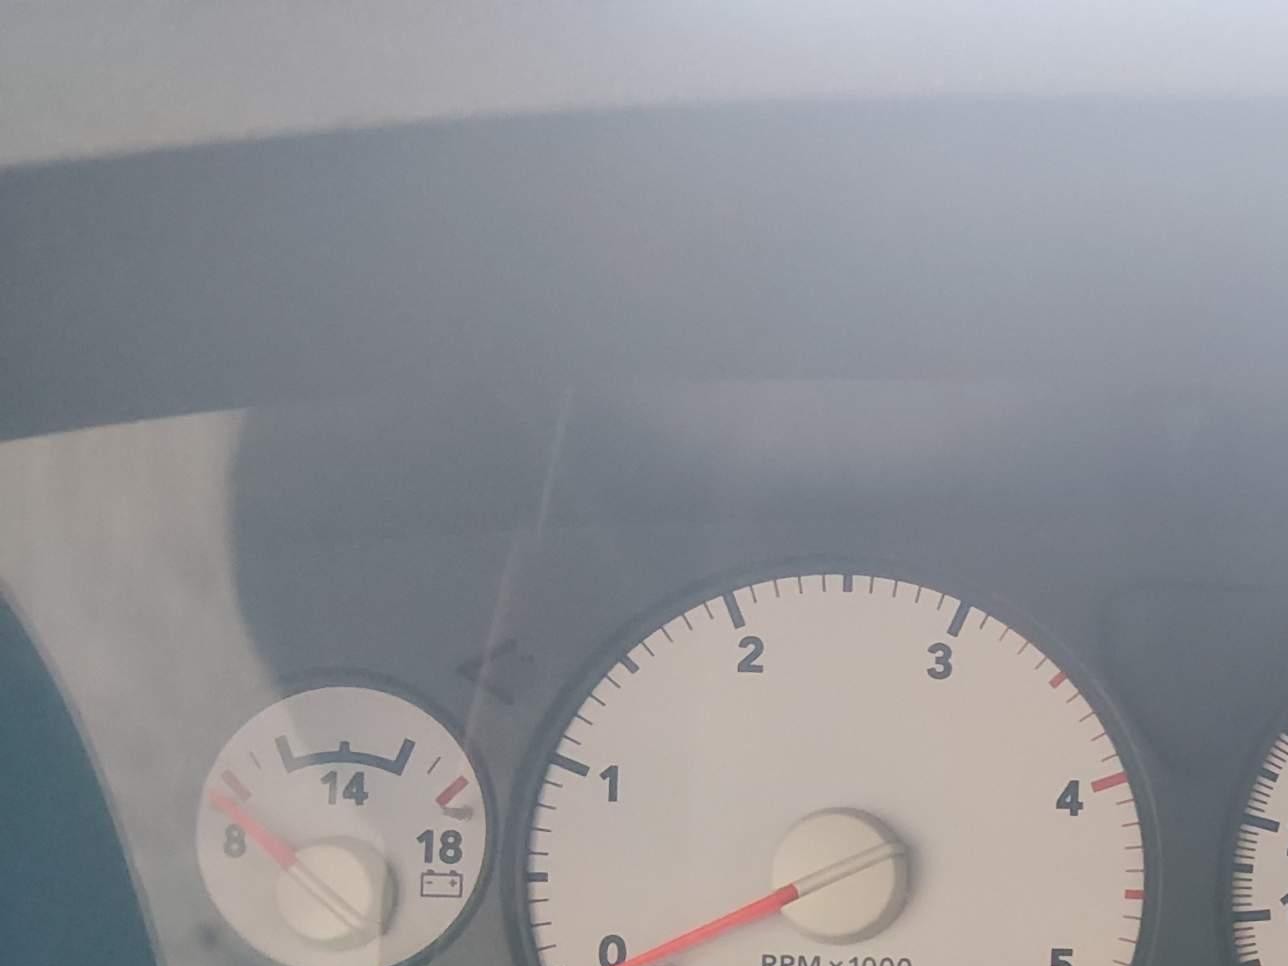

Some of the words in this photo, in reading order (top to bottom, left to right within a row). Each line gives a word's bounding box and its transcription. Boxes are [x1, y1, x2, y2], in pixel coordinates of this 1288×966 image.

[736, 636, 764, 673] 2
[927, 643, 953, 680] 3
[320, 771, 369, 806] 14
[599, 764, 619, 802] 1
[1055, 780, 1084, 816] 4
[223, 823, 247, 858] 8
[416, 829, 464, 865] 18
